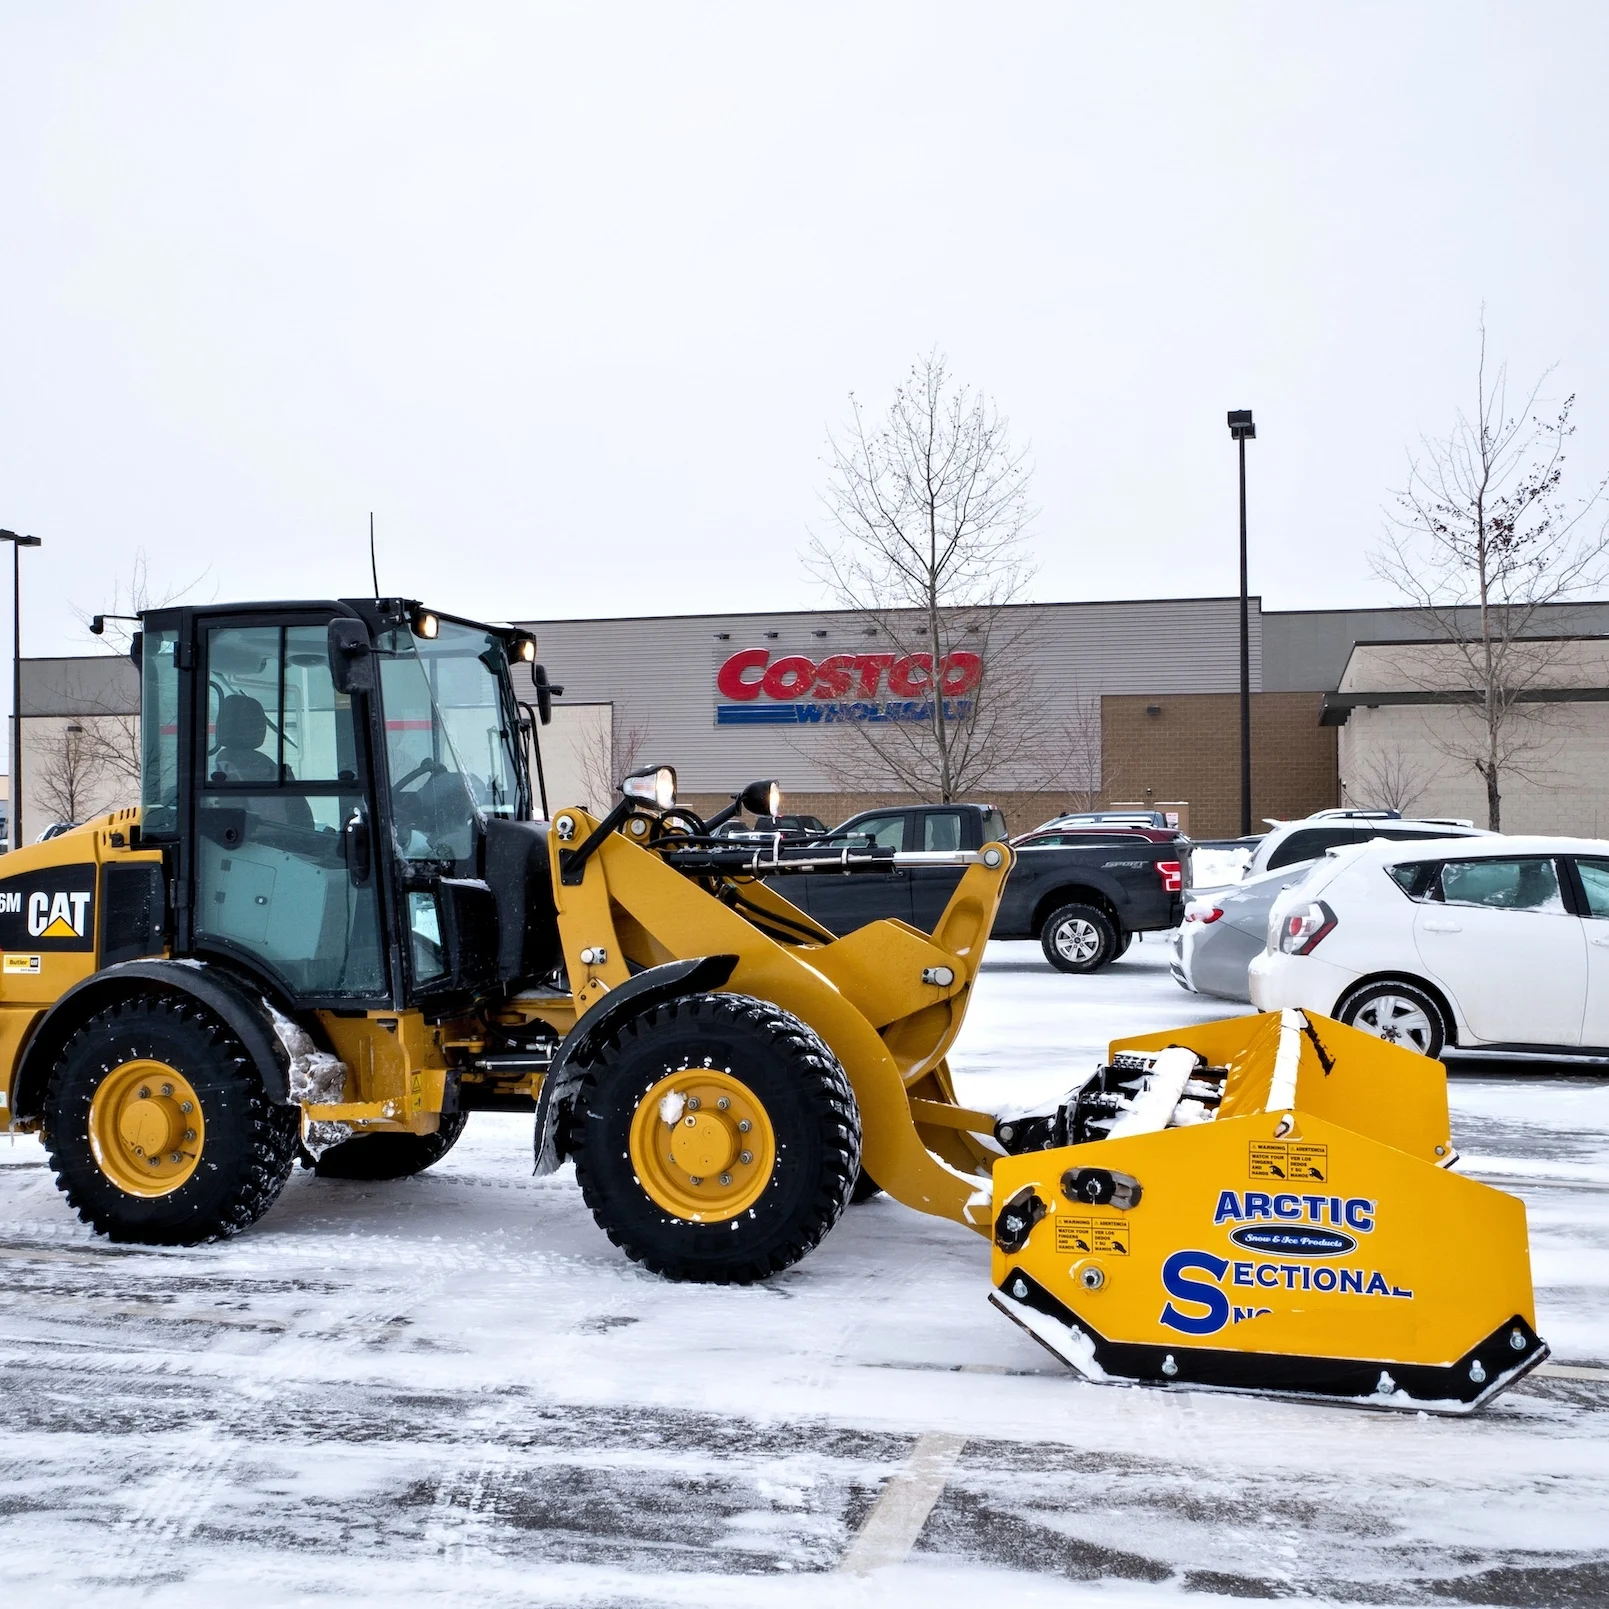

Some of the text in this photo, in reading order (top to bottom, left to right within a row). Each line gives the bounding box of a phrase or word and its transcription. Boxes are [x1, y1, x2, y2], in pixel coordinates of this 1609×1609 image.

[717, 648, 983, 700] COSTCO
[28, 892, 91, 937] CAT
[1214, 1191, 1375, 1232] ARCTIC
[1245, 1233, 1343, 1247] Snow & Ice Products
